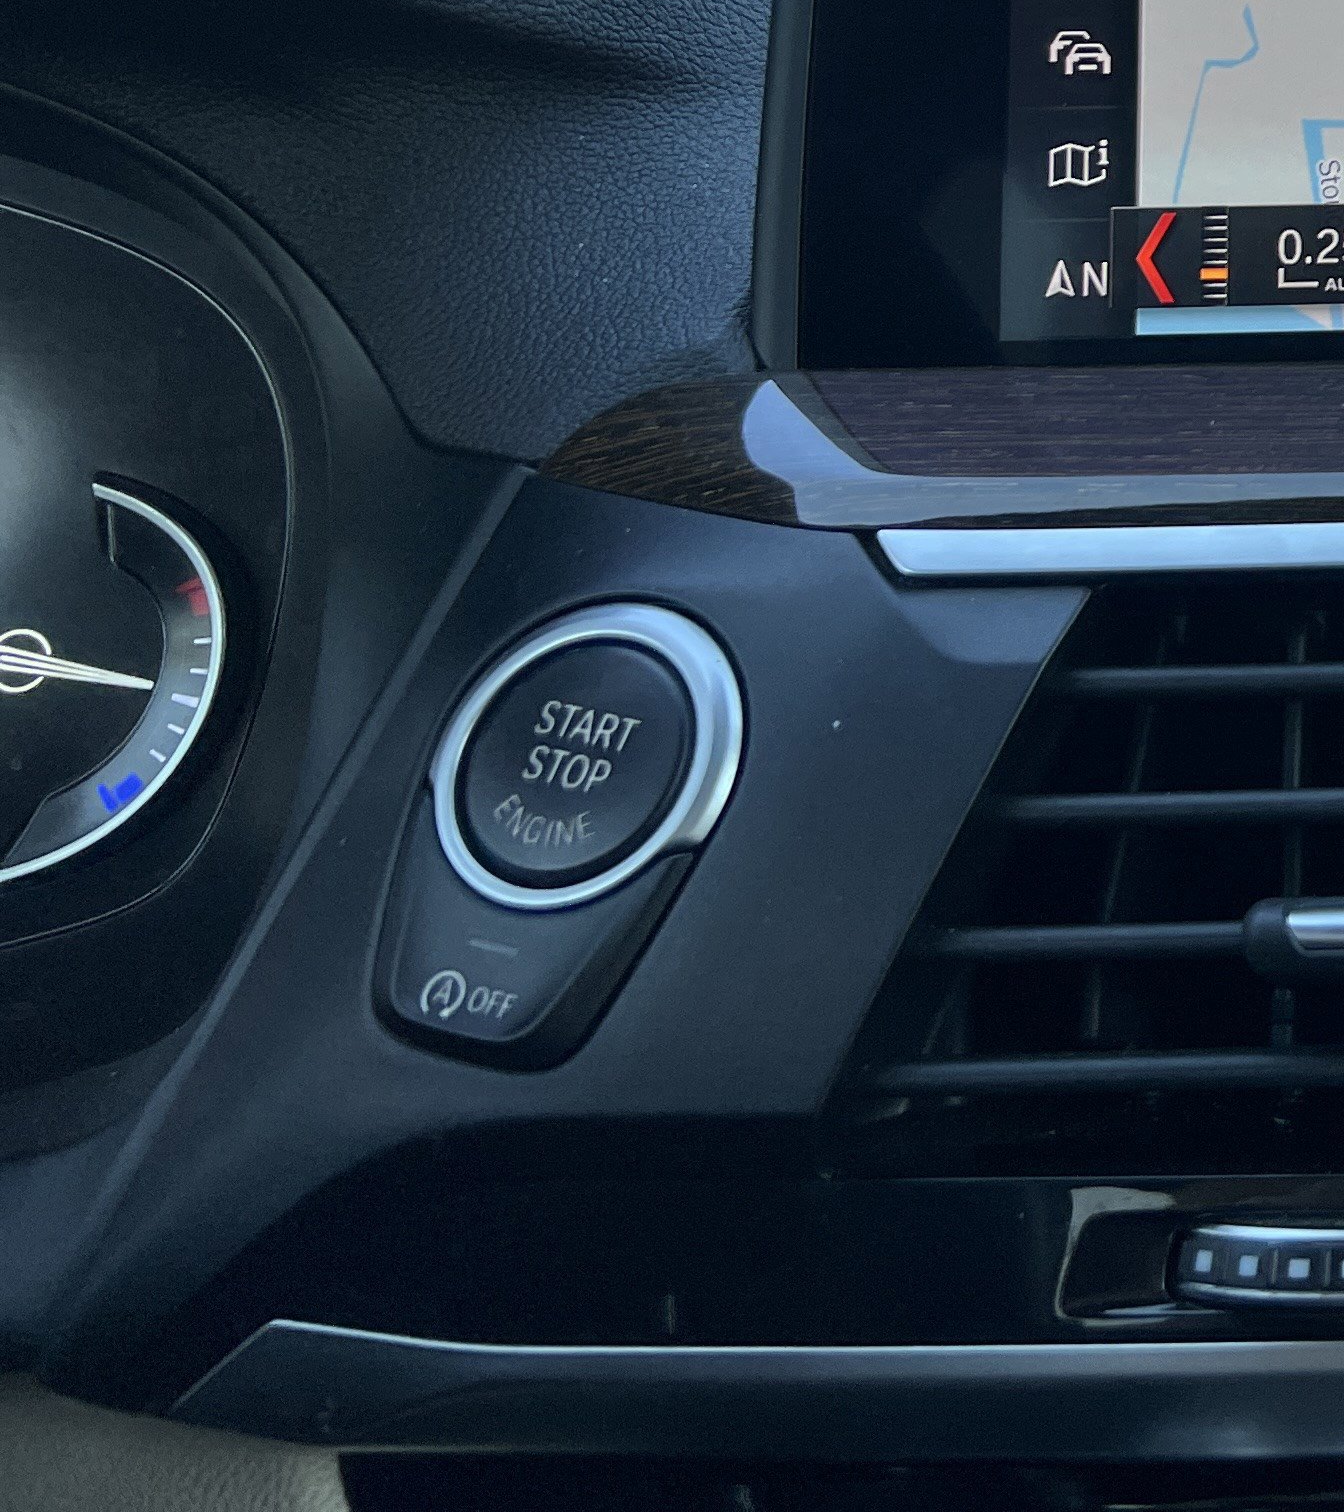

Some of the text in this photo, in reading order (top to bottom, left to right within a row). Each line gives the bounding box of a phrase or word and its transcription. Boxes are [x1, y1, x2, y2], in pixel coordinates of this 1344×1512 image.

[533, 700, 643, 752] START
[521, 745, 613, 793] STOP
[493, 794, 596, 847] ENGINE
[467, 986, 519, 1020] OFF
